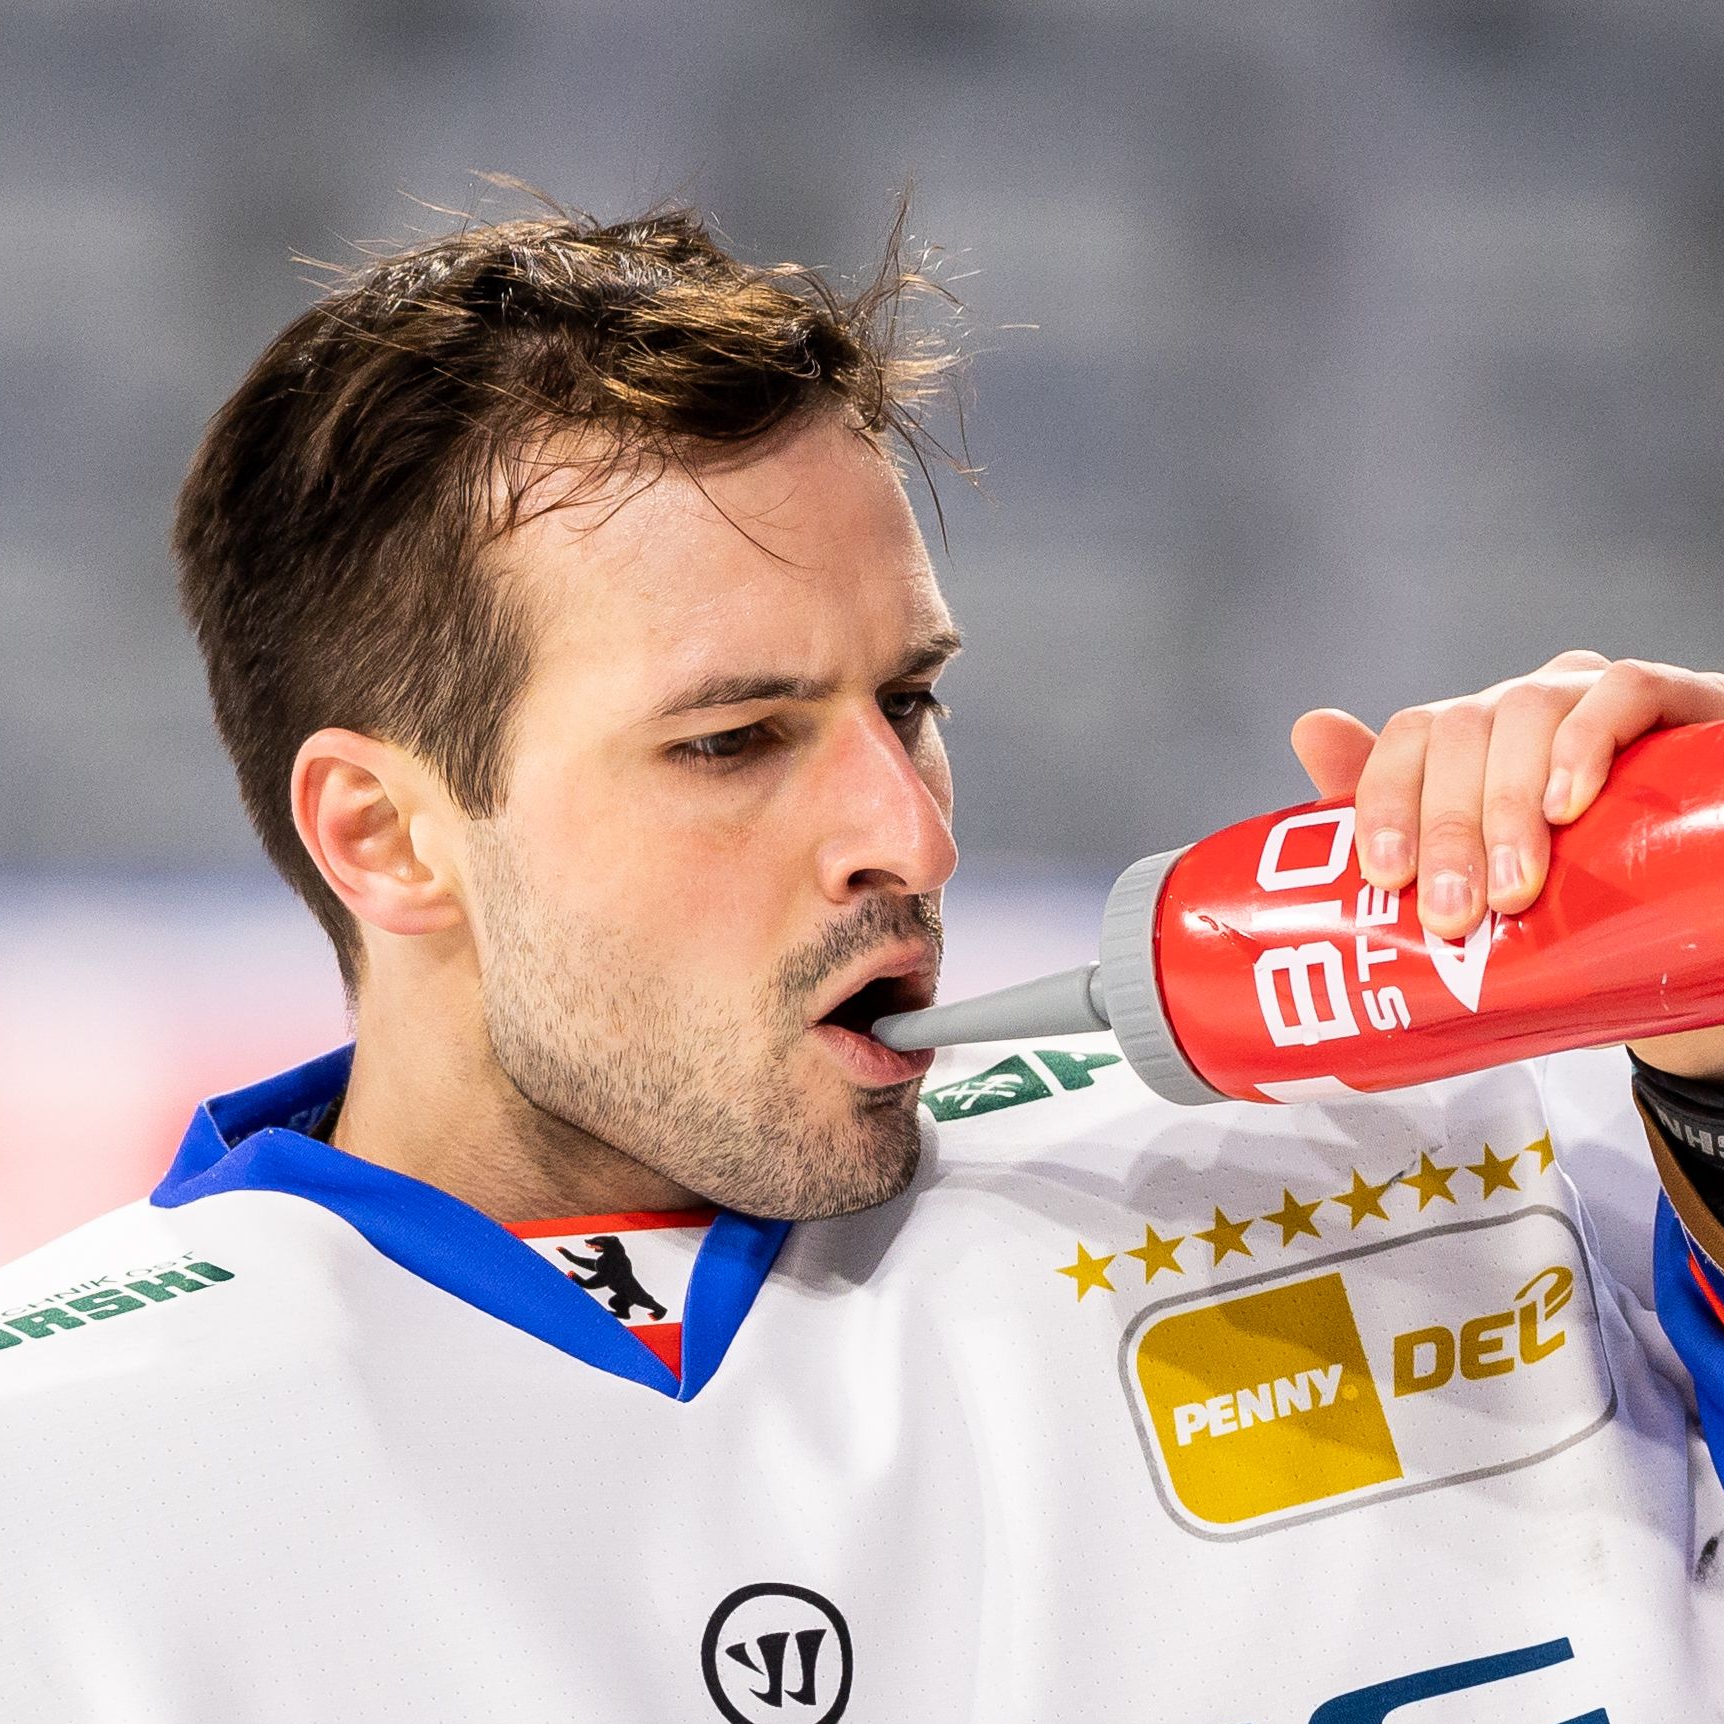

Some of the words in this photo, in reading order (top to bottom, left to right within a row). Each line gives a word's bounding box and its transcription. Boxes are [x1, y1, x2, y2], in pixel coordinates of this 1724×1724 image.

[1253, 806, 1358, 1048] BIO
[1355, 872, 1412, 1032] STE
[124, 1250, 196, 1279] OST
[1173, 1362, 1344, 1447] PENNY
[1392, 1266, 1574, 1398] DEL
